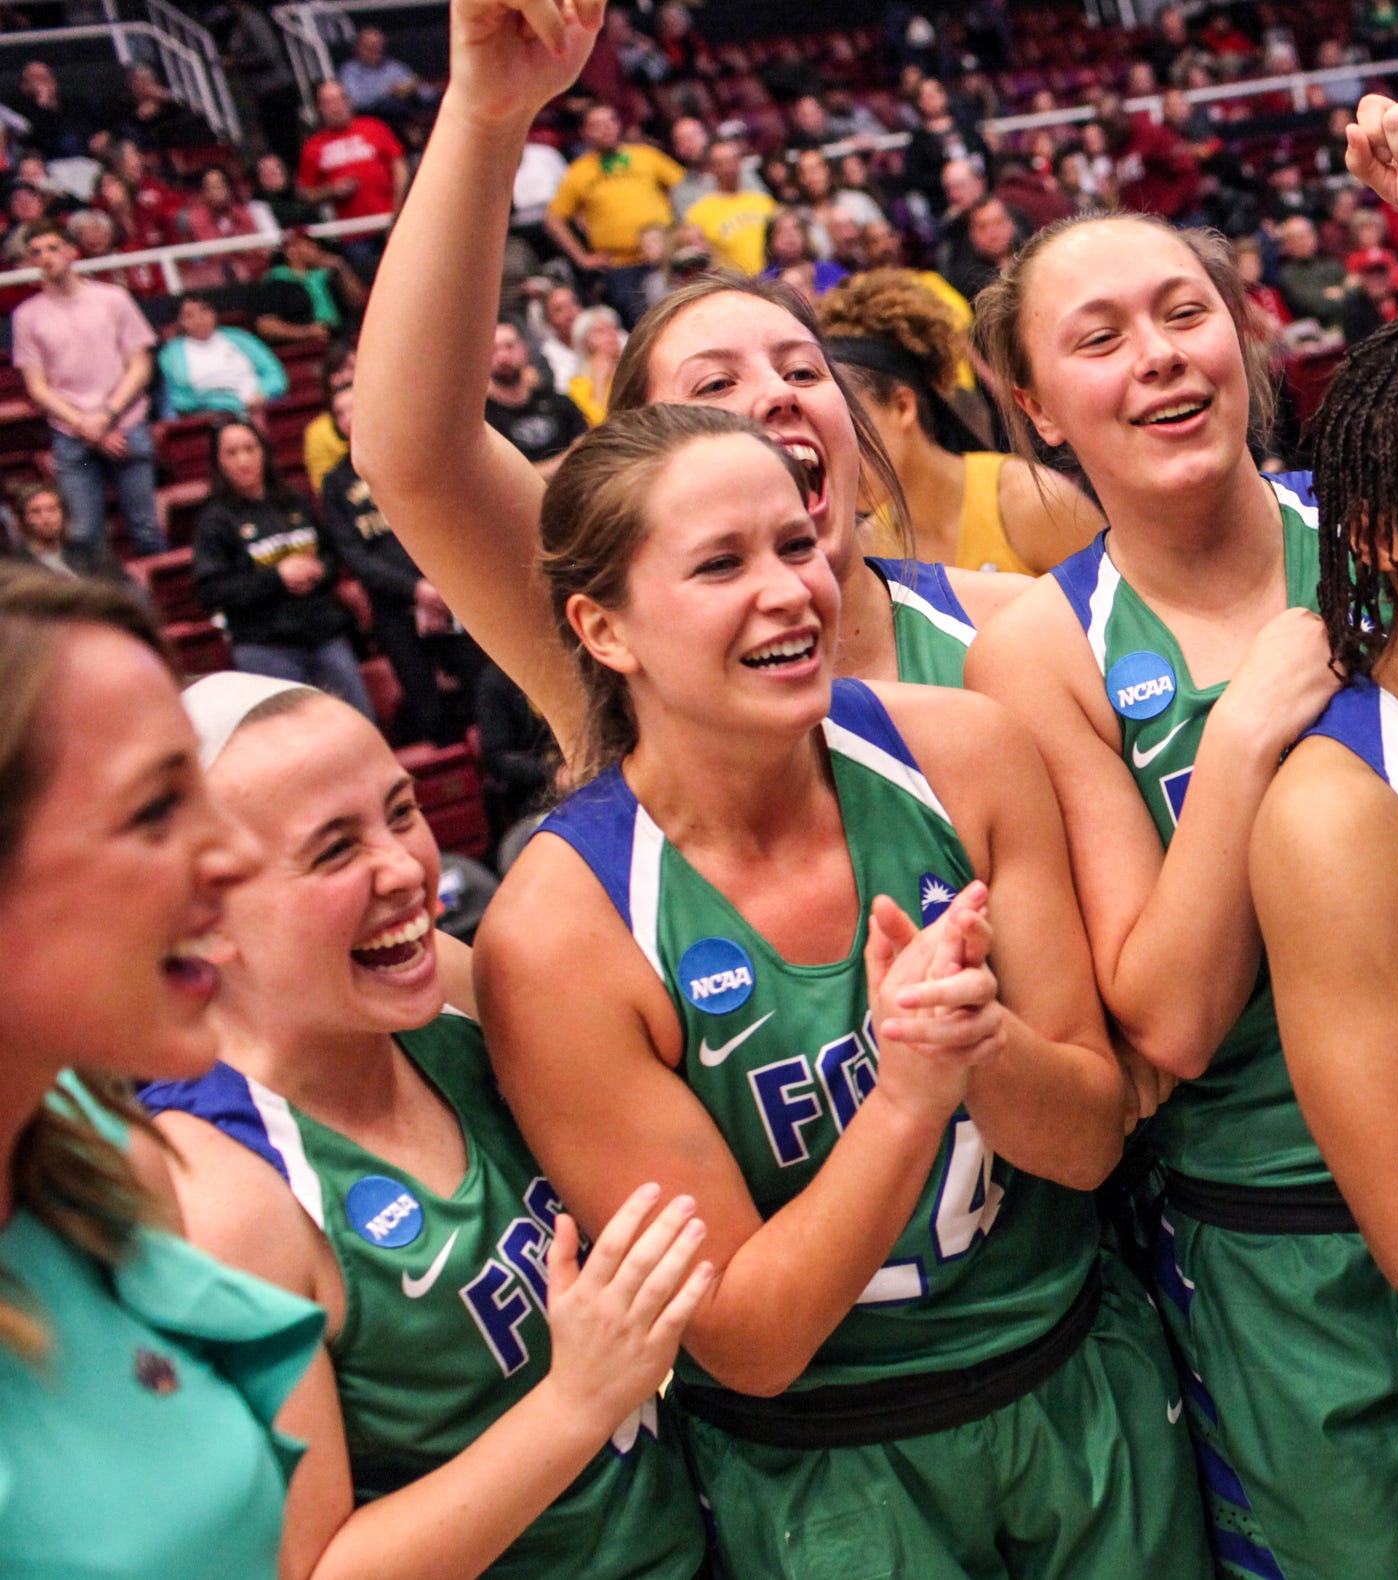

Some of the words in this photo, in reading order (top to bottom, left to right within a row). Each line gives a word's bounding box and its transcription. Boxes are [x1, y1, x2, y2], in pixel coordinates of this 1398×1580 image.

[1117, 675, 1173, 709] NCAA
[689, 966, 753, 1001] NCAA
[365, 1193, 420, 1241] NCAA
